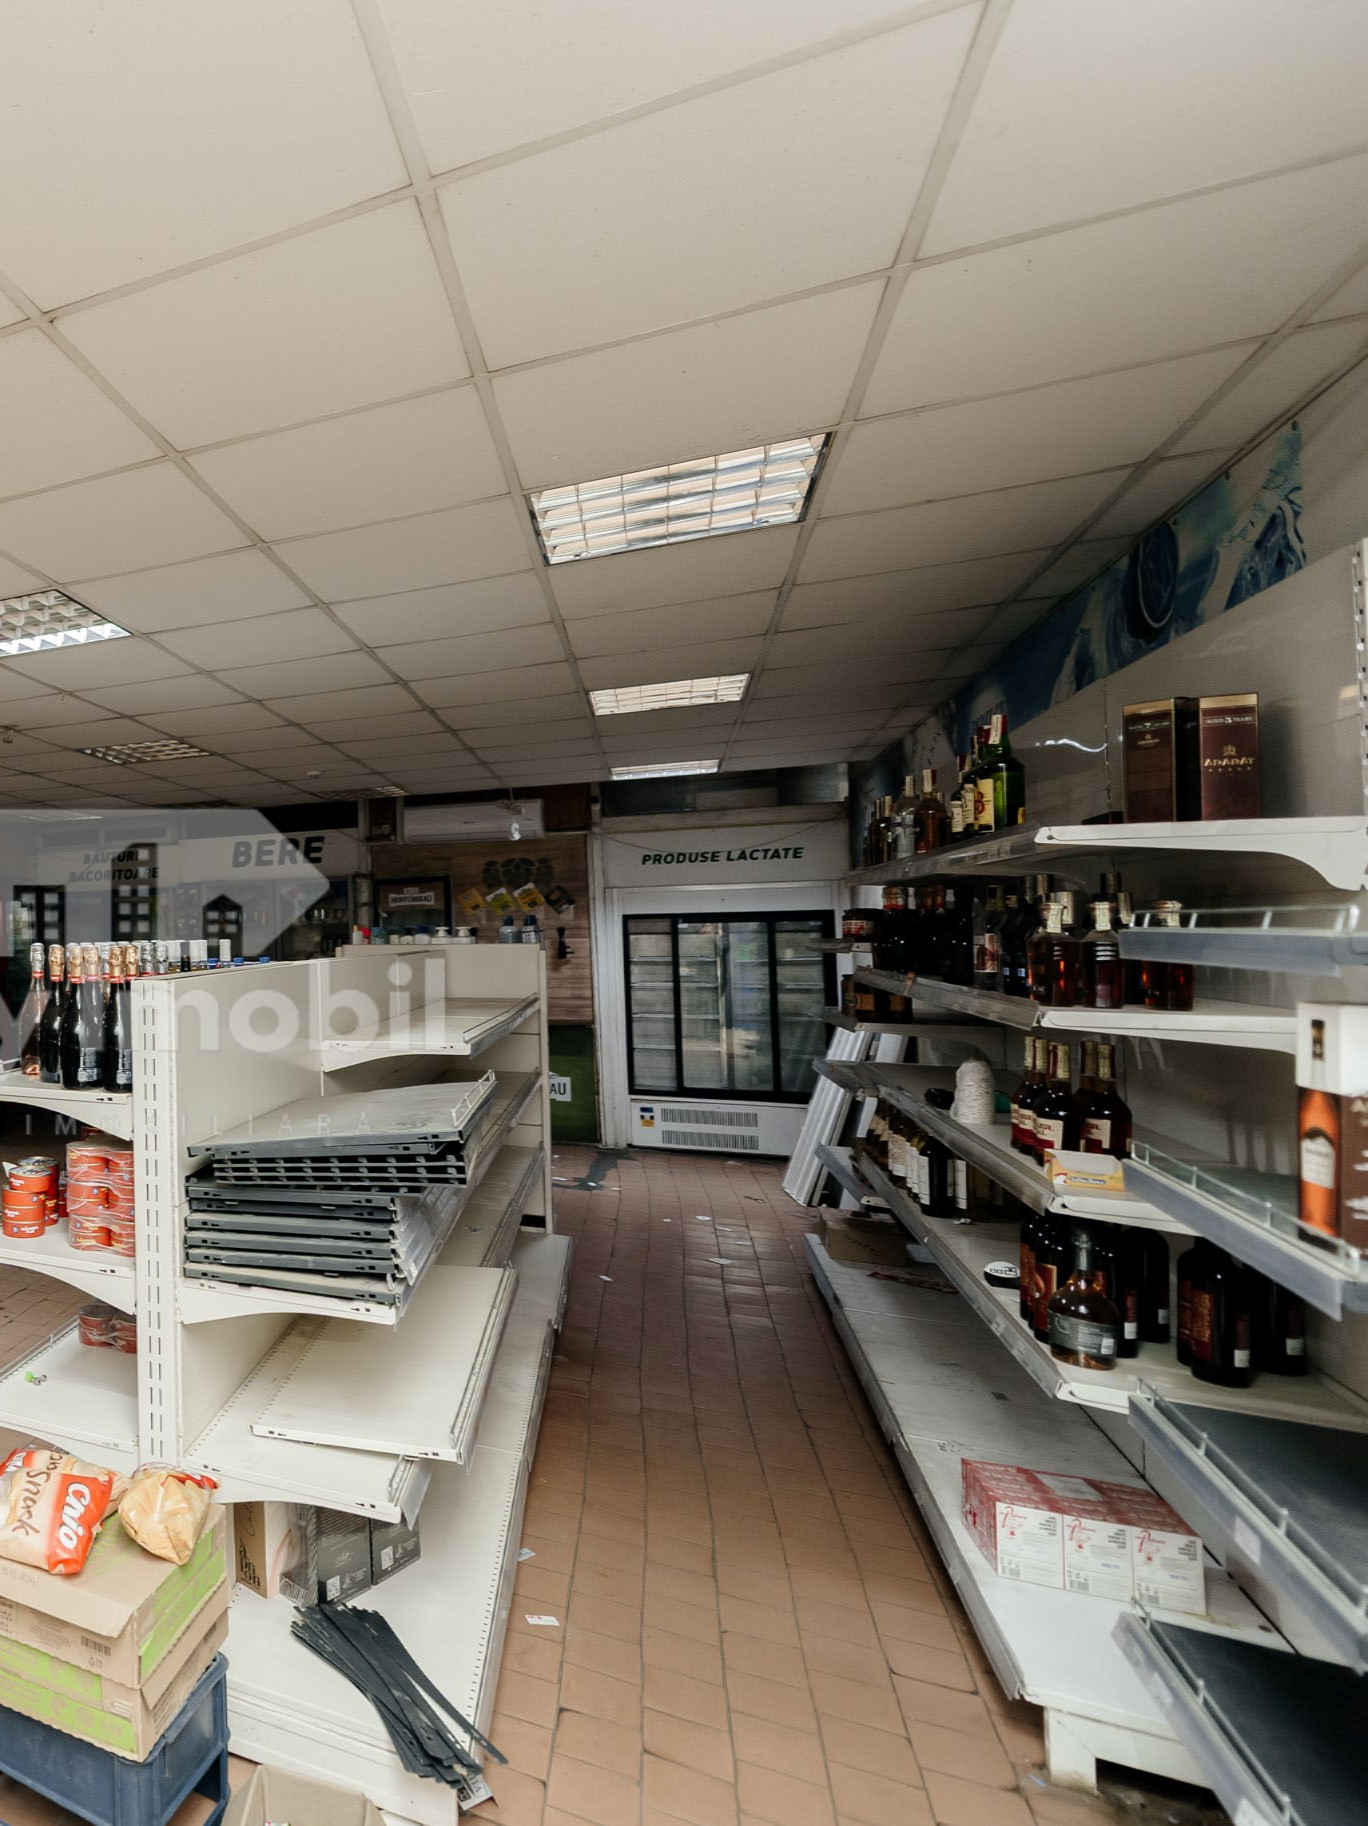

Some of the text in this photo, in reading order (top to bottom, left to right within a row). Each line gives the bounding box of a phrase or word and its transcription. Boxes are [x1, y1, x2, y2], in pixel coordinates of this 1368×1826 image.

[231, 836, 326, 869] BERE
[641, 847, 805, 866] PRODUSE LACTATE
[11, 1466, 52, 1537] Snack
[58, 1481, 92, 1550] Chio
